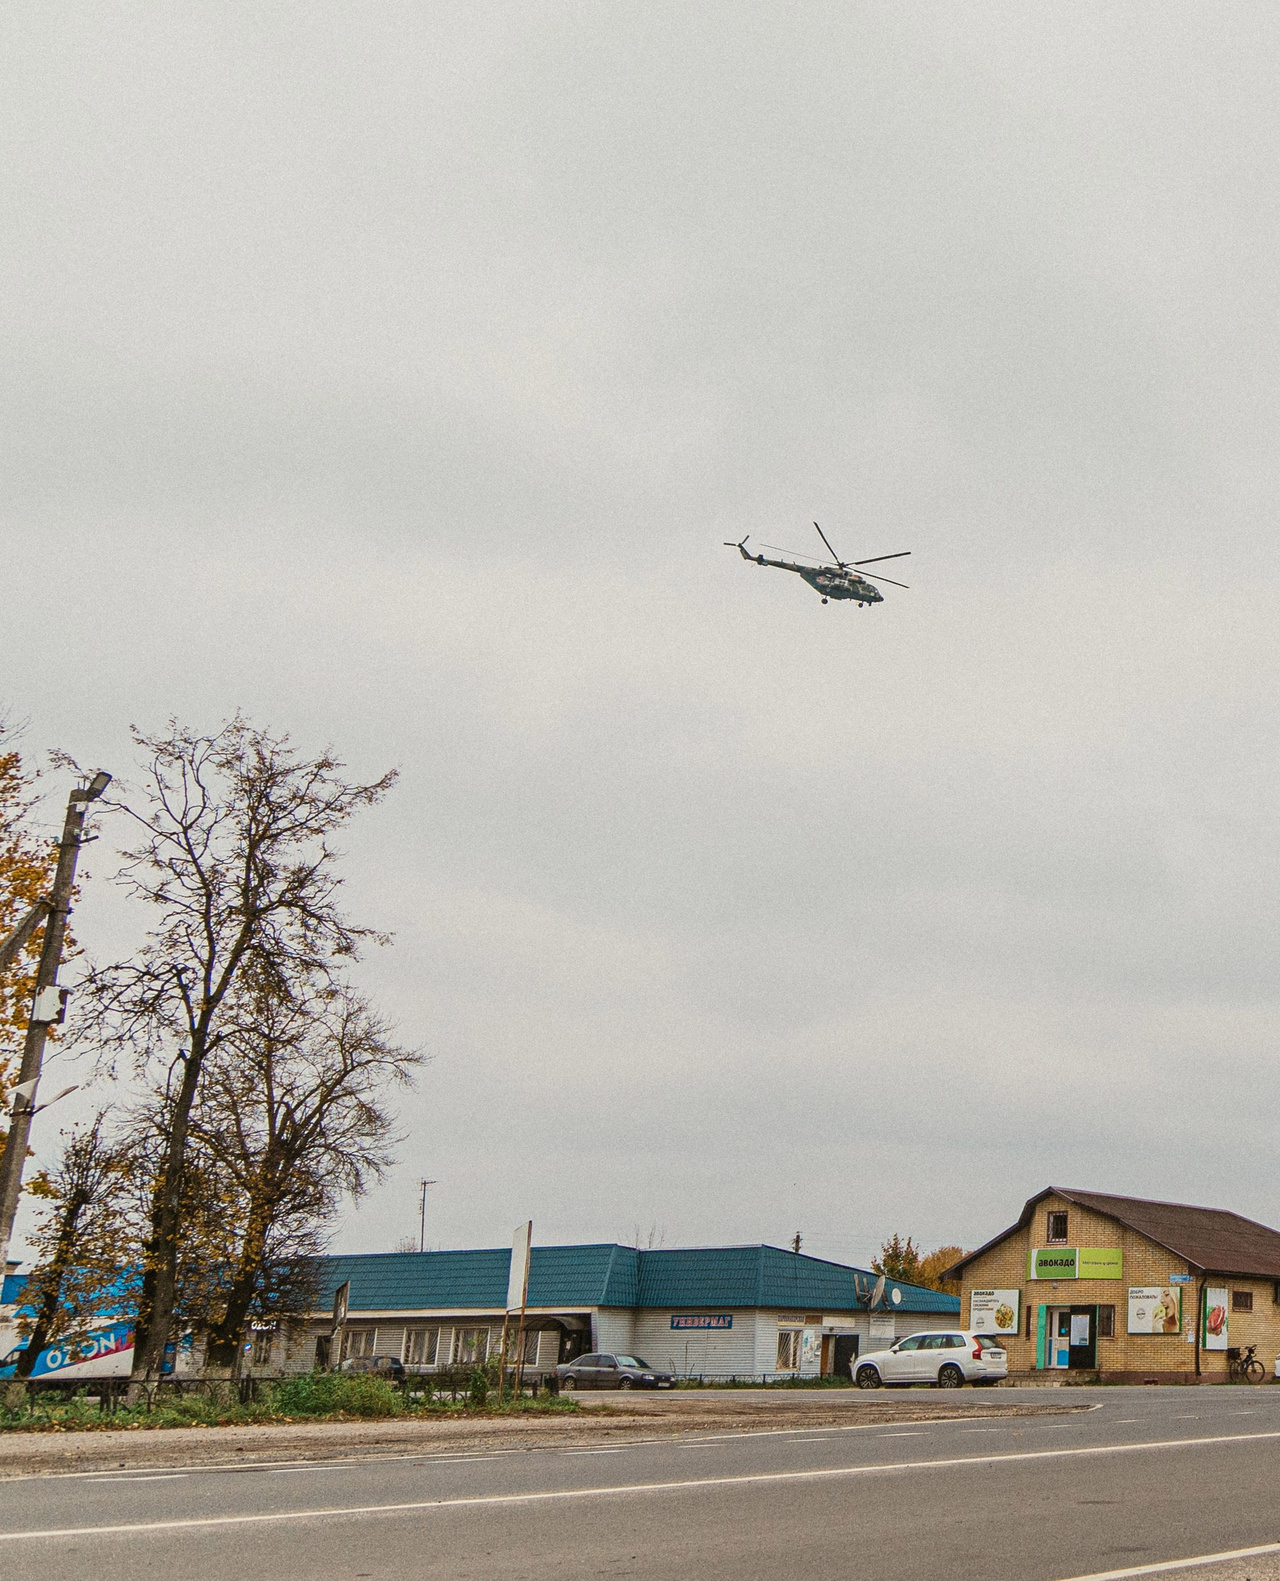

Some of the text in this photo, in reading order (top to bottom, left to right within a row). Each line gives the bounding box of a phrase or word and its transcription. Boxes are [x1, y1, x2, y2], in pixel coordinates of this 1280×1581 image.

[1038, 1259, 1075, 1267] авокадо
[673, 1317, 730, 1326] УНИВЕРМАГ
[46, 1333, 116, 1368] OZON
